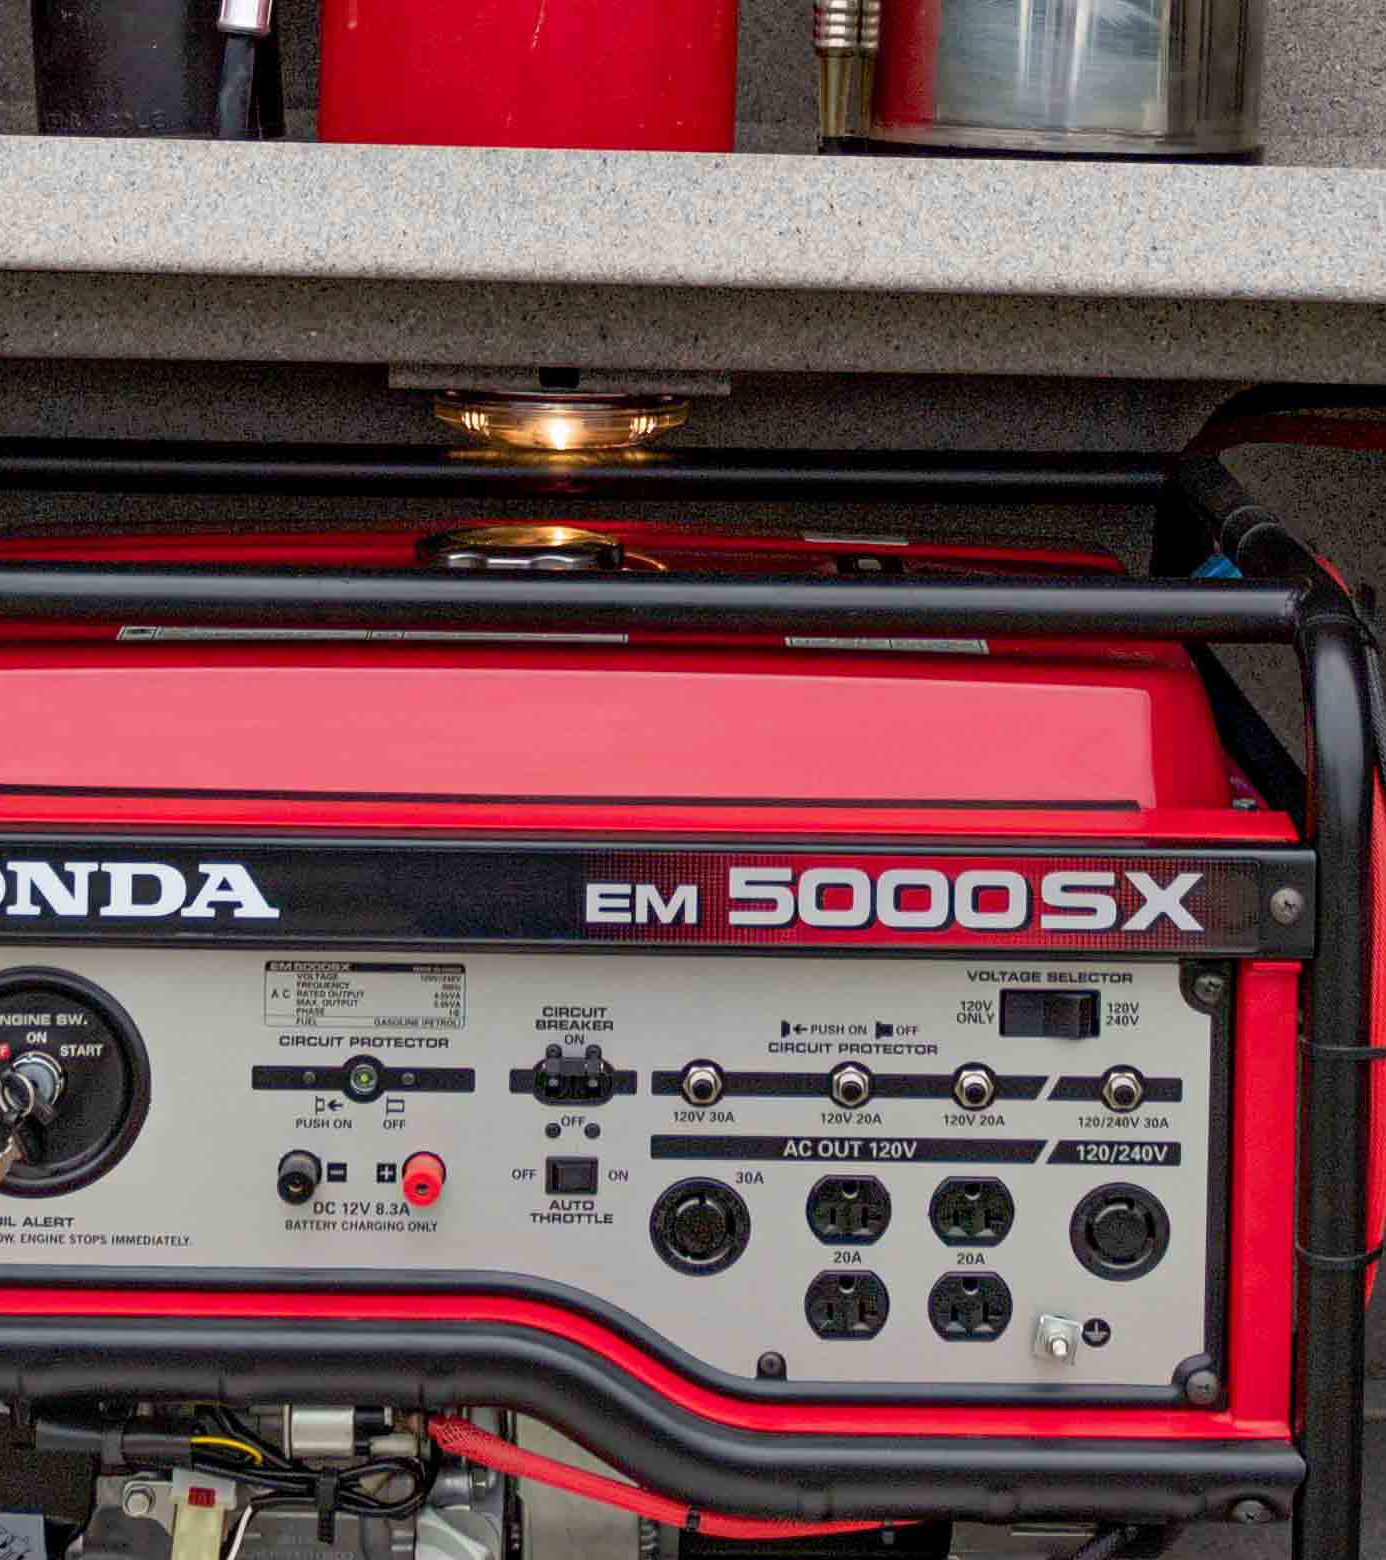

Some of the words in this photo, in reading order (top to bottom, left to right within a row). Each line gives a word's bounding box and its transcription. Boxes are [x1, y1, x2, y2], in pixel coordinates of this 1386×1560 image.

[586, 883, 698, 925] EM
[728, 867, 1205, 932] 5000SX
[967, 971, 1044, 983] VOLTAGE
[1047, 972, 1133, 984] SELECTOR
[960, 1001, 993, 1012] 120V
[1107, 1002, 1140, 1014] 120V
[542, 1007, 607, 1019] CIRCUIT
[956, 1012, 995, 1025] ONLY
[56, 1014, 88, 1026] SW.
[535, 1019, 614, 1031] BREAKER
[1106, 1015, 1140, 1026] 240V
[810, 1024, 845, 1035] PUSH
[848, 1024, 867, 1035] ON
[896, 1025, 920, 1036] OFF
[27, 1032, 47, 1044] ON
[278, 1036, 344, 1047] CIRCUIT
[349, 1037, 449, 1048] PROTECTOR
[564, 1034, 586, 1046] ON
[60, 1045, 103, 1057] START
[768, 1042, 833, 1054] CIRCUIT
[838, 1043, 939, 1055] PROTECTOR
[560, 1115, 585, 1127] OFF
[674, 1111, 705, 1122] 120V
[709, 1111, 735, 1122] 30A
[821, 1112, 853, 1124] 120V
[856, 1113, 882, 1125] 20A
[944, 1114, 976, 1126] 120V
[979, 1115, 1005, 1126] 20A
[295, 1118, 330, 1129] PUSH
[333, 1118, 353, 1129] ON
[383, 1118, 406, 1130] OFF
[1078, 1117, 1140, 1129] 120/240V
[1144, 1118, 1169, 1129] 30A
[783, 1140, 812, 1157] AC
[817, 1141, 862, 1157] OUT
[868, 1141, 918, 1158] 120V
[1076, 1144, 1168, 1163] 120/240V
[511, 1168, 537, 1181] OFF
[608, 1169, 629, 1181] ON
[735, 1172, 764, 1184] 30A
[313, 1202, 336, 1215] DC
[342, 1202, 371, 1215] 12V
[375, 1202, 411, 1216] 8.3A
[549, 1200, 594, 1212] AUTO
[22, 1216, 75, 1228] ALERT
[530, 1212, 614, 1225] THROTTLE
[285, 1220, 338, 1231] BATTERY
[341, 1220, 405, 1232] CHARGING
[408, 1220, 438, 1232] ONLY
[20, 1233, 65, 1244] ENGINE
[69, 1234, 107, 1245] STOPS
[111, 1235, 193, 1246] IMMEDIATELY.
[833, 1251, 862, 1265] 20A
[956, 1251, 986, 1266] 20A
